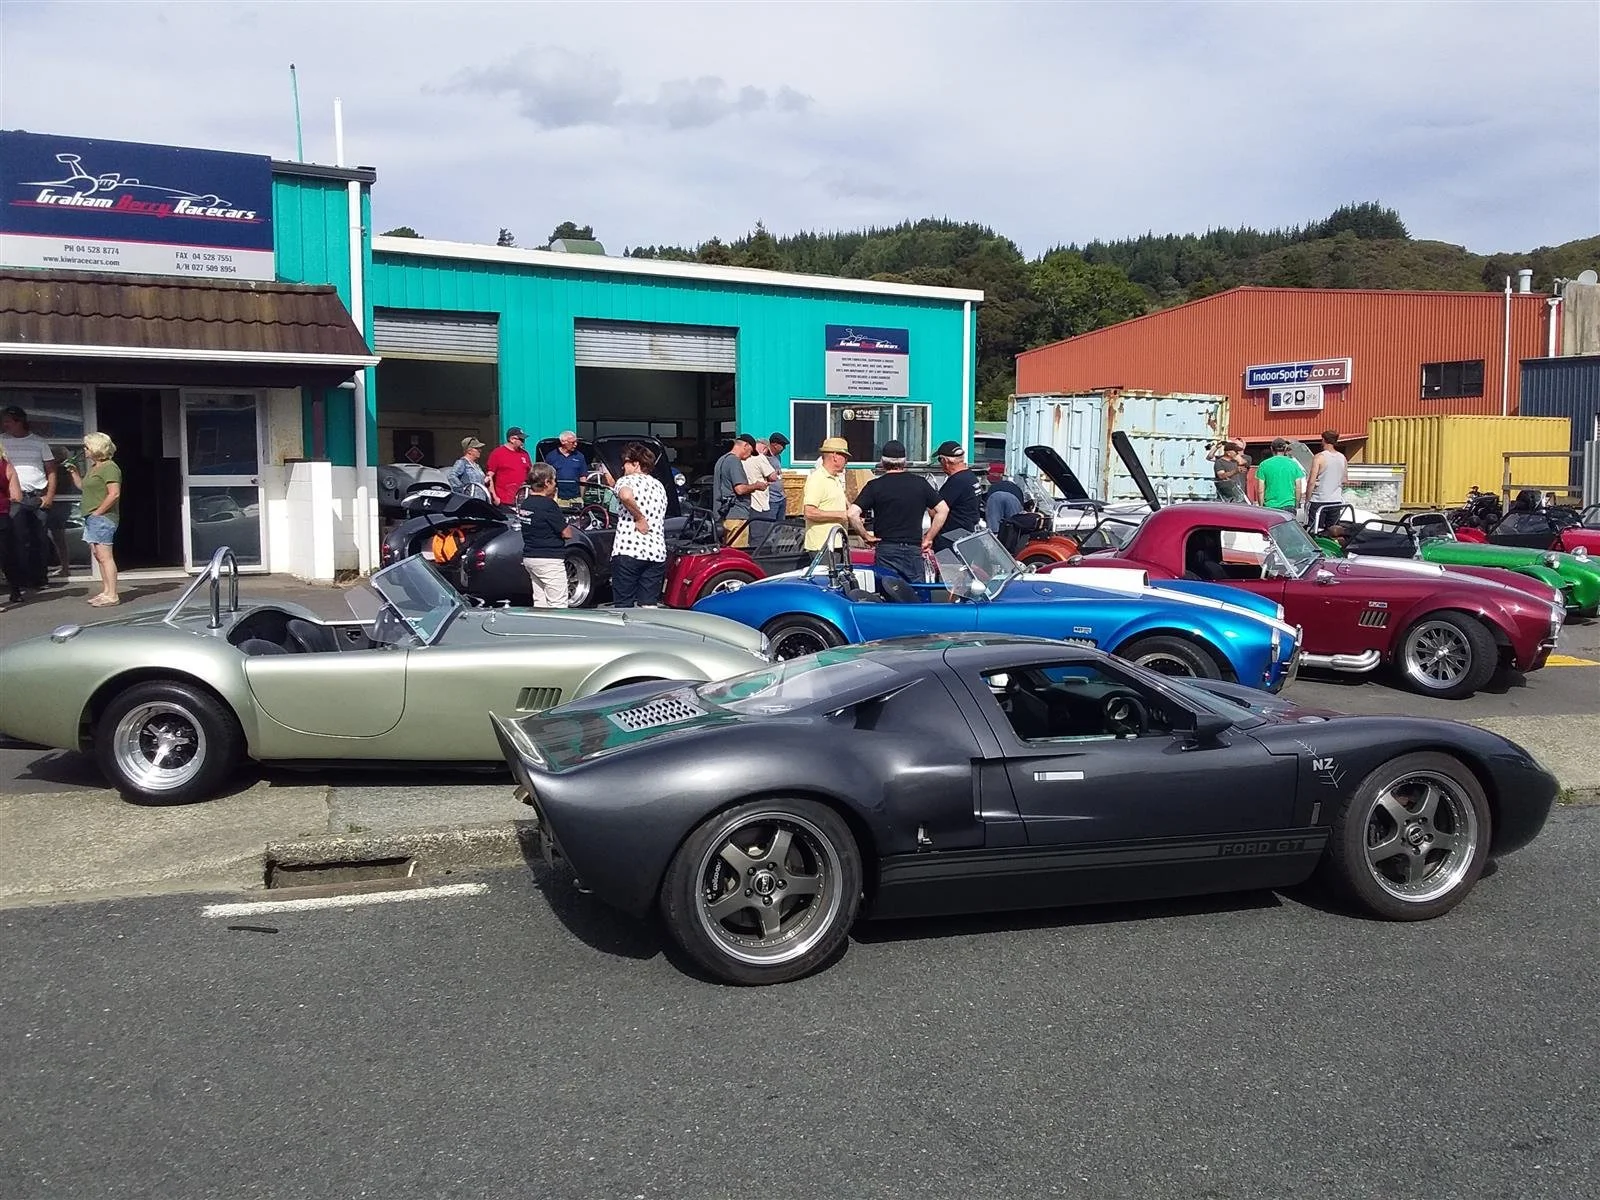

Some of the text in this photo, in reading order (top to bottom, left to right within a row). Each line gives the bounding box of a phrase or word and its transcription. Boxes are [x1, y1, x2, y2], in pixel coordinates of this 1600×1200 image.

[36, 188, 257, 219] Graham Berry Racecars
[64, 244, 119, 255] PH 04 528 8774
[43, 255, 120, 266] www.kiwiracecars.com
[175, 251, 188, 259] FAX
[217, 254, 232, 262] 7551
[175, 263, 190, 271] A/H
[205, 264, 219, 272] 509
[220, 265, 236, 273] 8954
[1253, 367, 1340, 383] IndoorSports.co.nz
[1312, 757, 1334, 771] NZ
[1222, 840, 1304, 856] FORD GT
